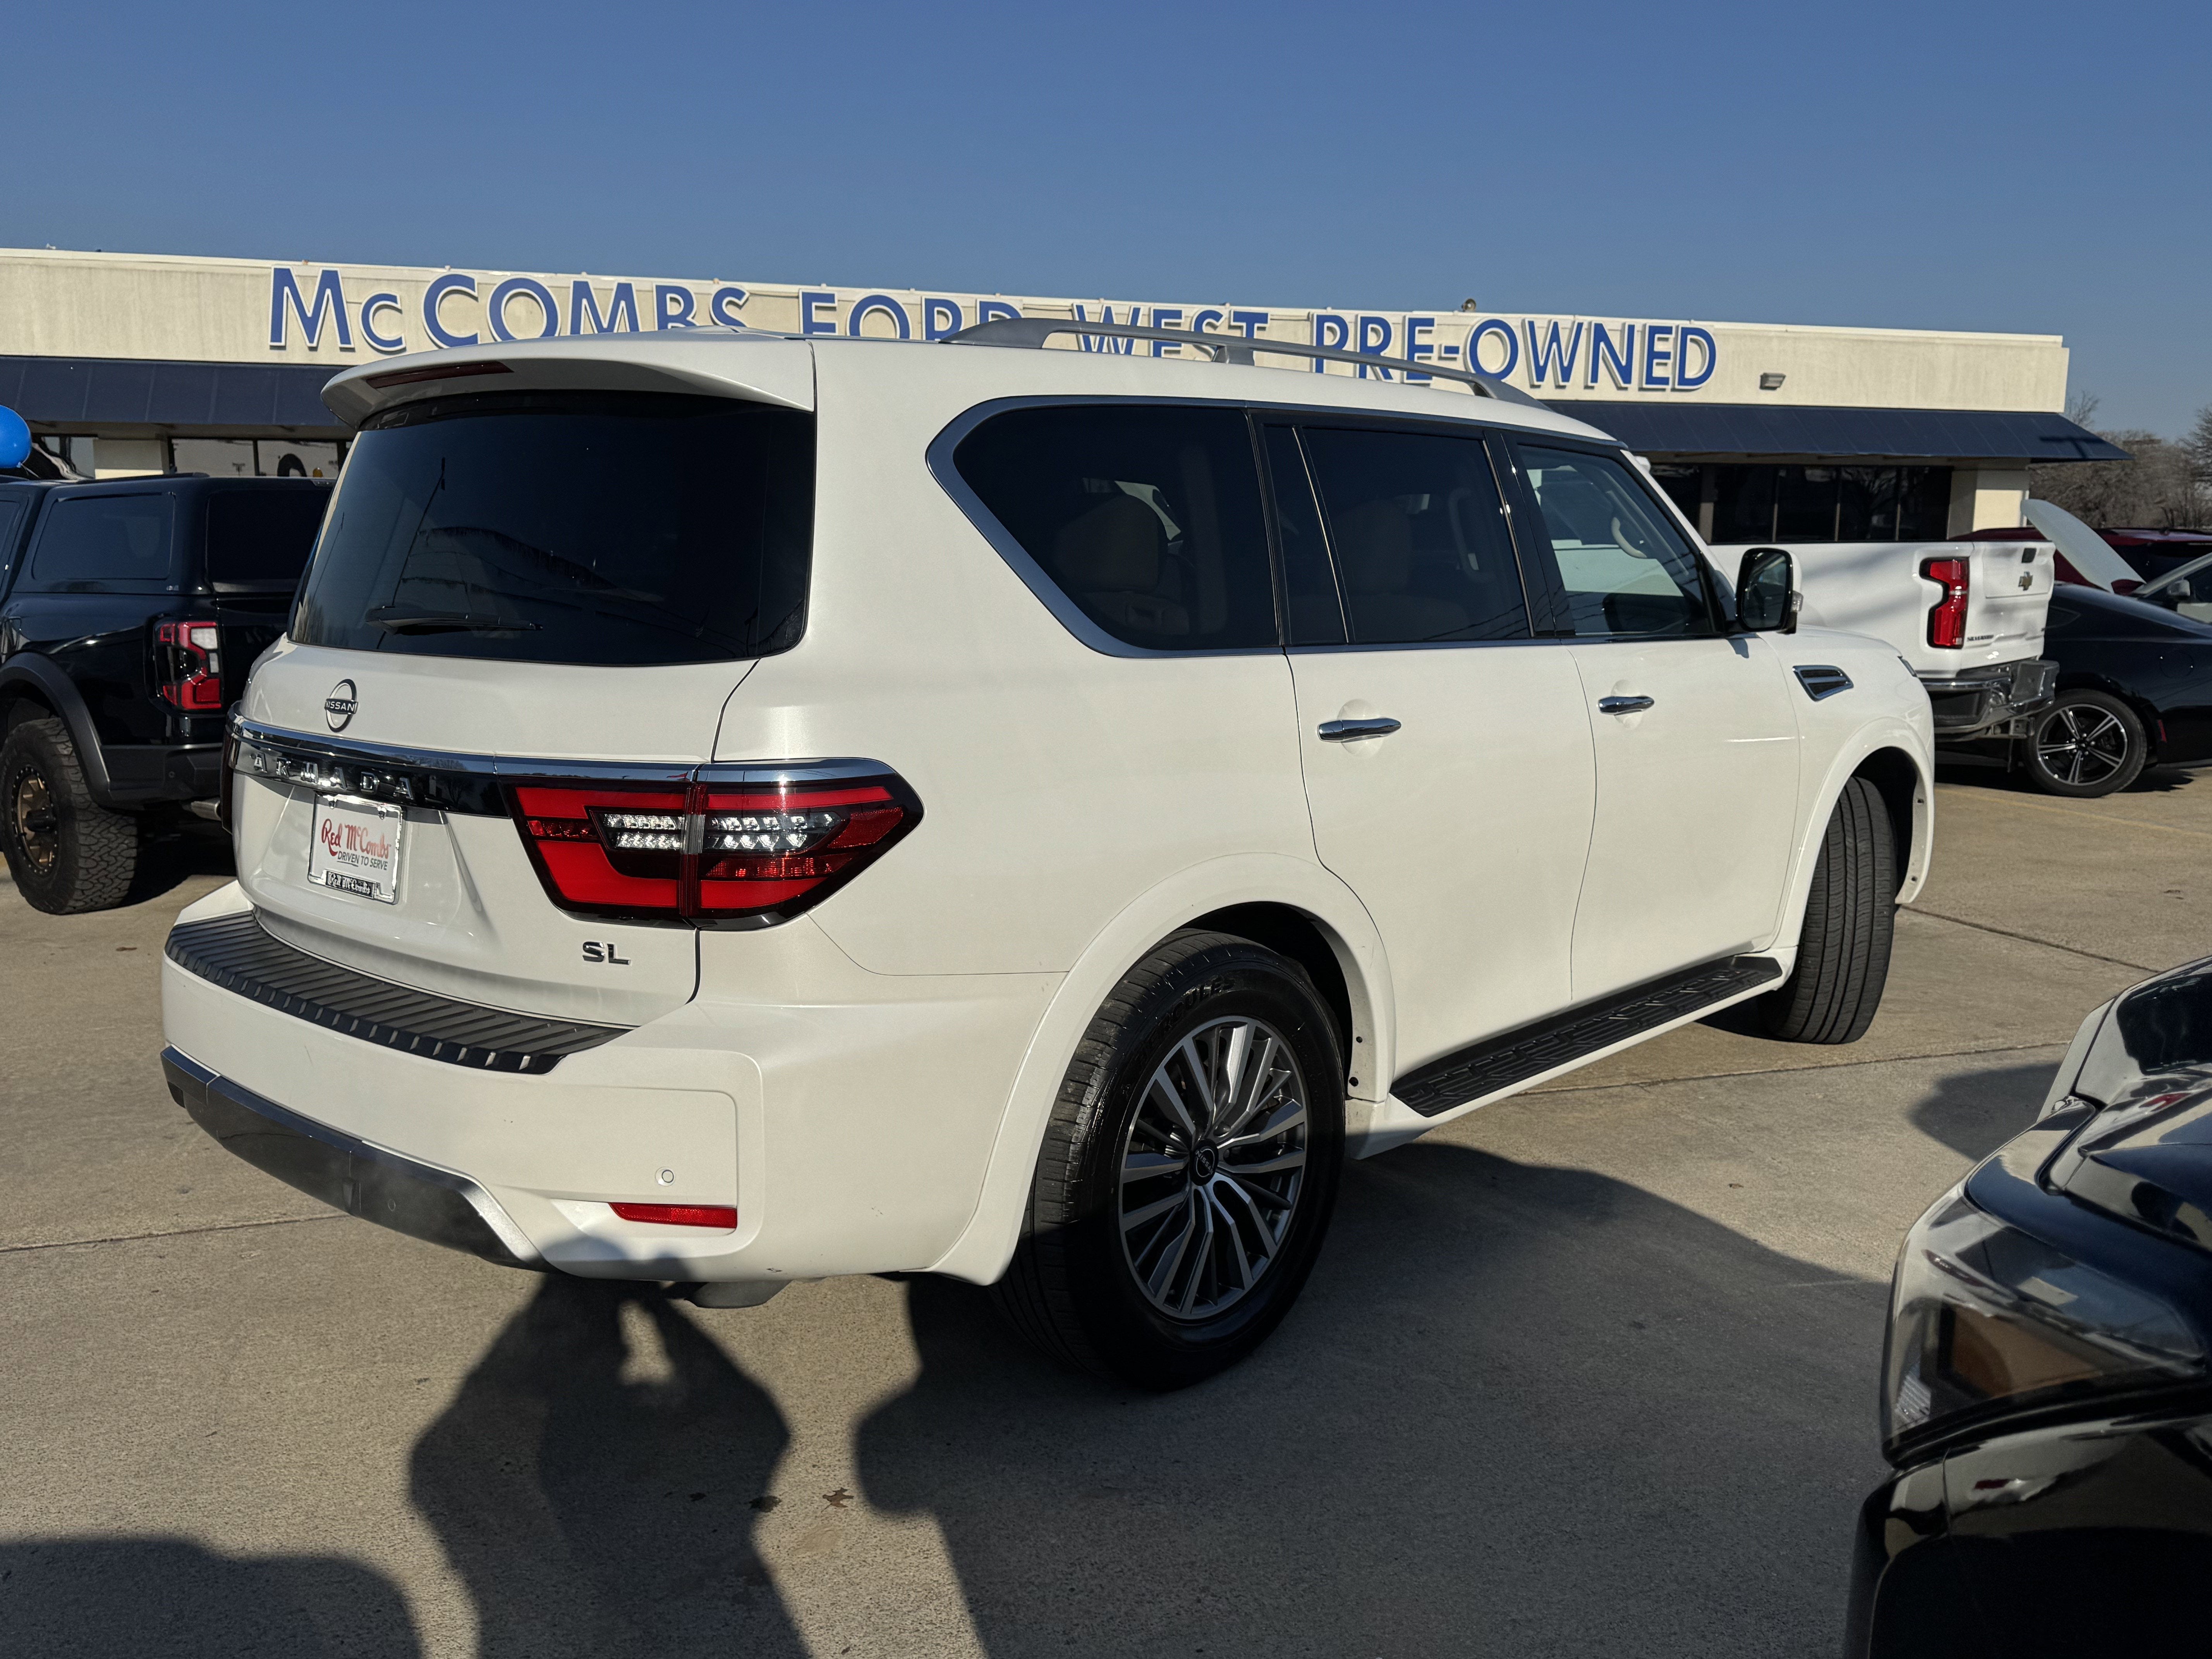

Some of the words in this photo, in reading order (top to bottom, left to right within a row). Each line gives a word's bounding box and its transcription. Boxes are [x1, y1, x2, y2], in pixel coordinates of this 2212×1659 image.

[799, 289, 1024, 342] FOR
[1313, 313, 1718, 391] PRE-OWNED
[253, 752, 415, 800] ARMADA
[321, 818, 343, 857] Red
[344, 823, 390, 859] McCombs
[338, 851, 360, 864] DRIVEN
[361, 856, 369, 866] TO
[370, 858, 388, 871] SERVE
[582, 941, 631, 965] SL
